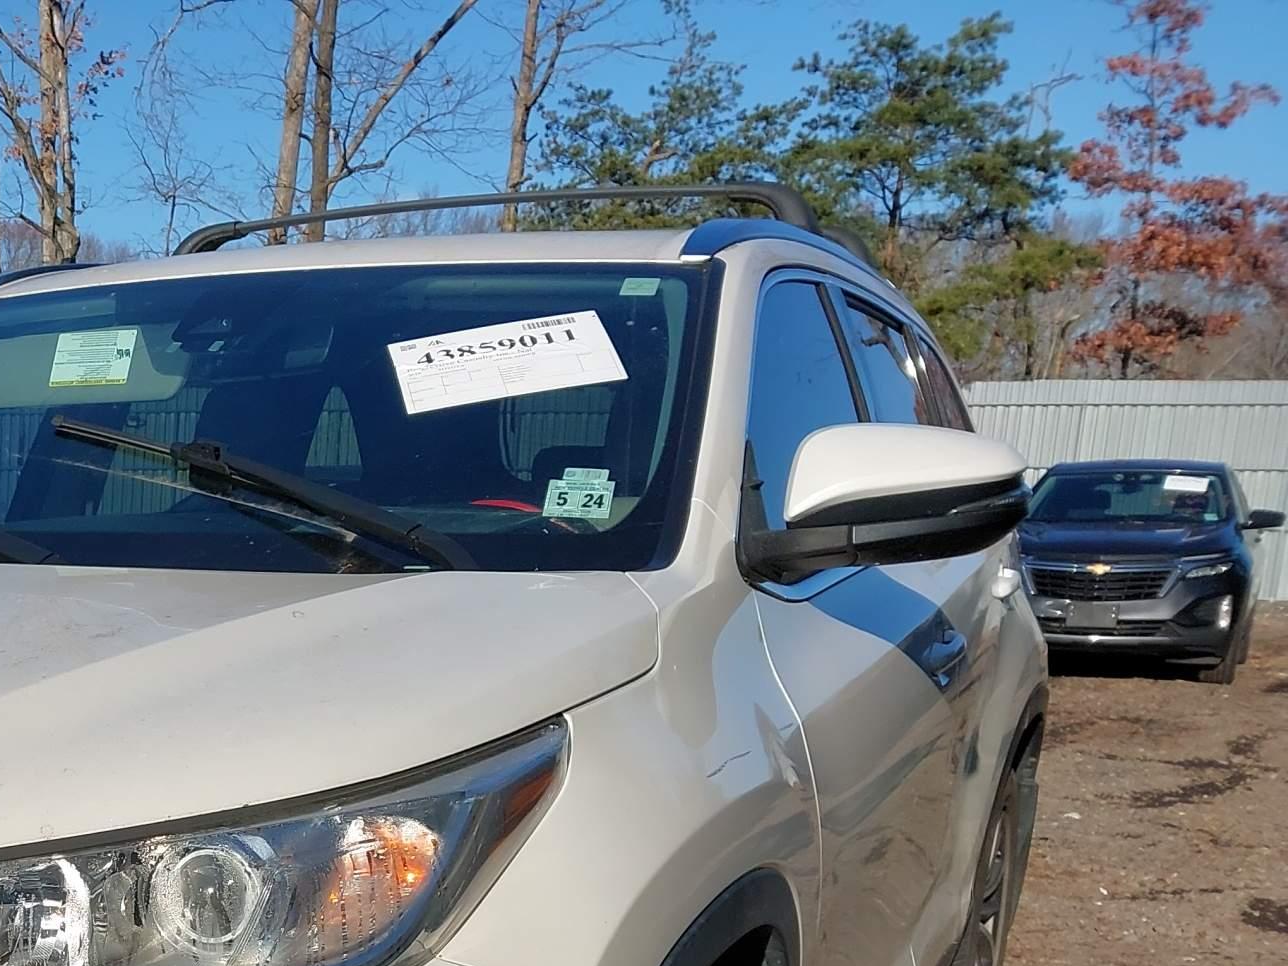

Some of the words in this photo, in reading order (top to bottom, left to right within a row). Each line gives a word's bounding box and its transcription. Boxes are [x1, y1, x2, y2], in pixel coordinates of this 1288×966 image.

[417, 328, 576, 364] 43859011
[556, 491, 569, 506] 5
[580, 493, 605, 509] 24
